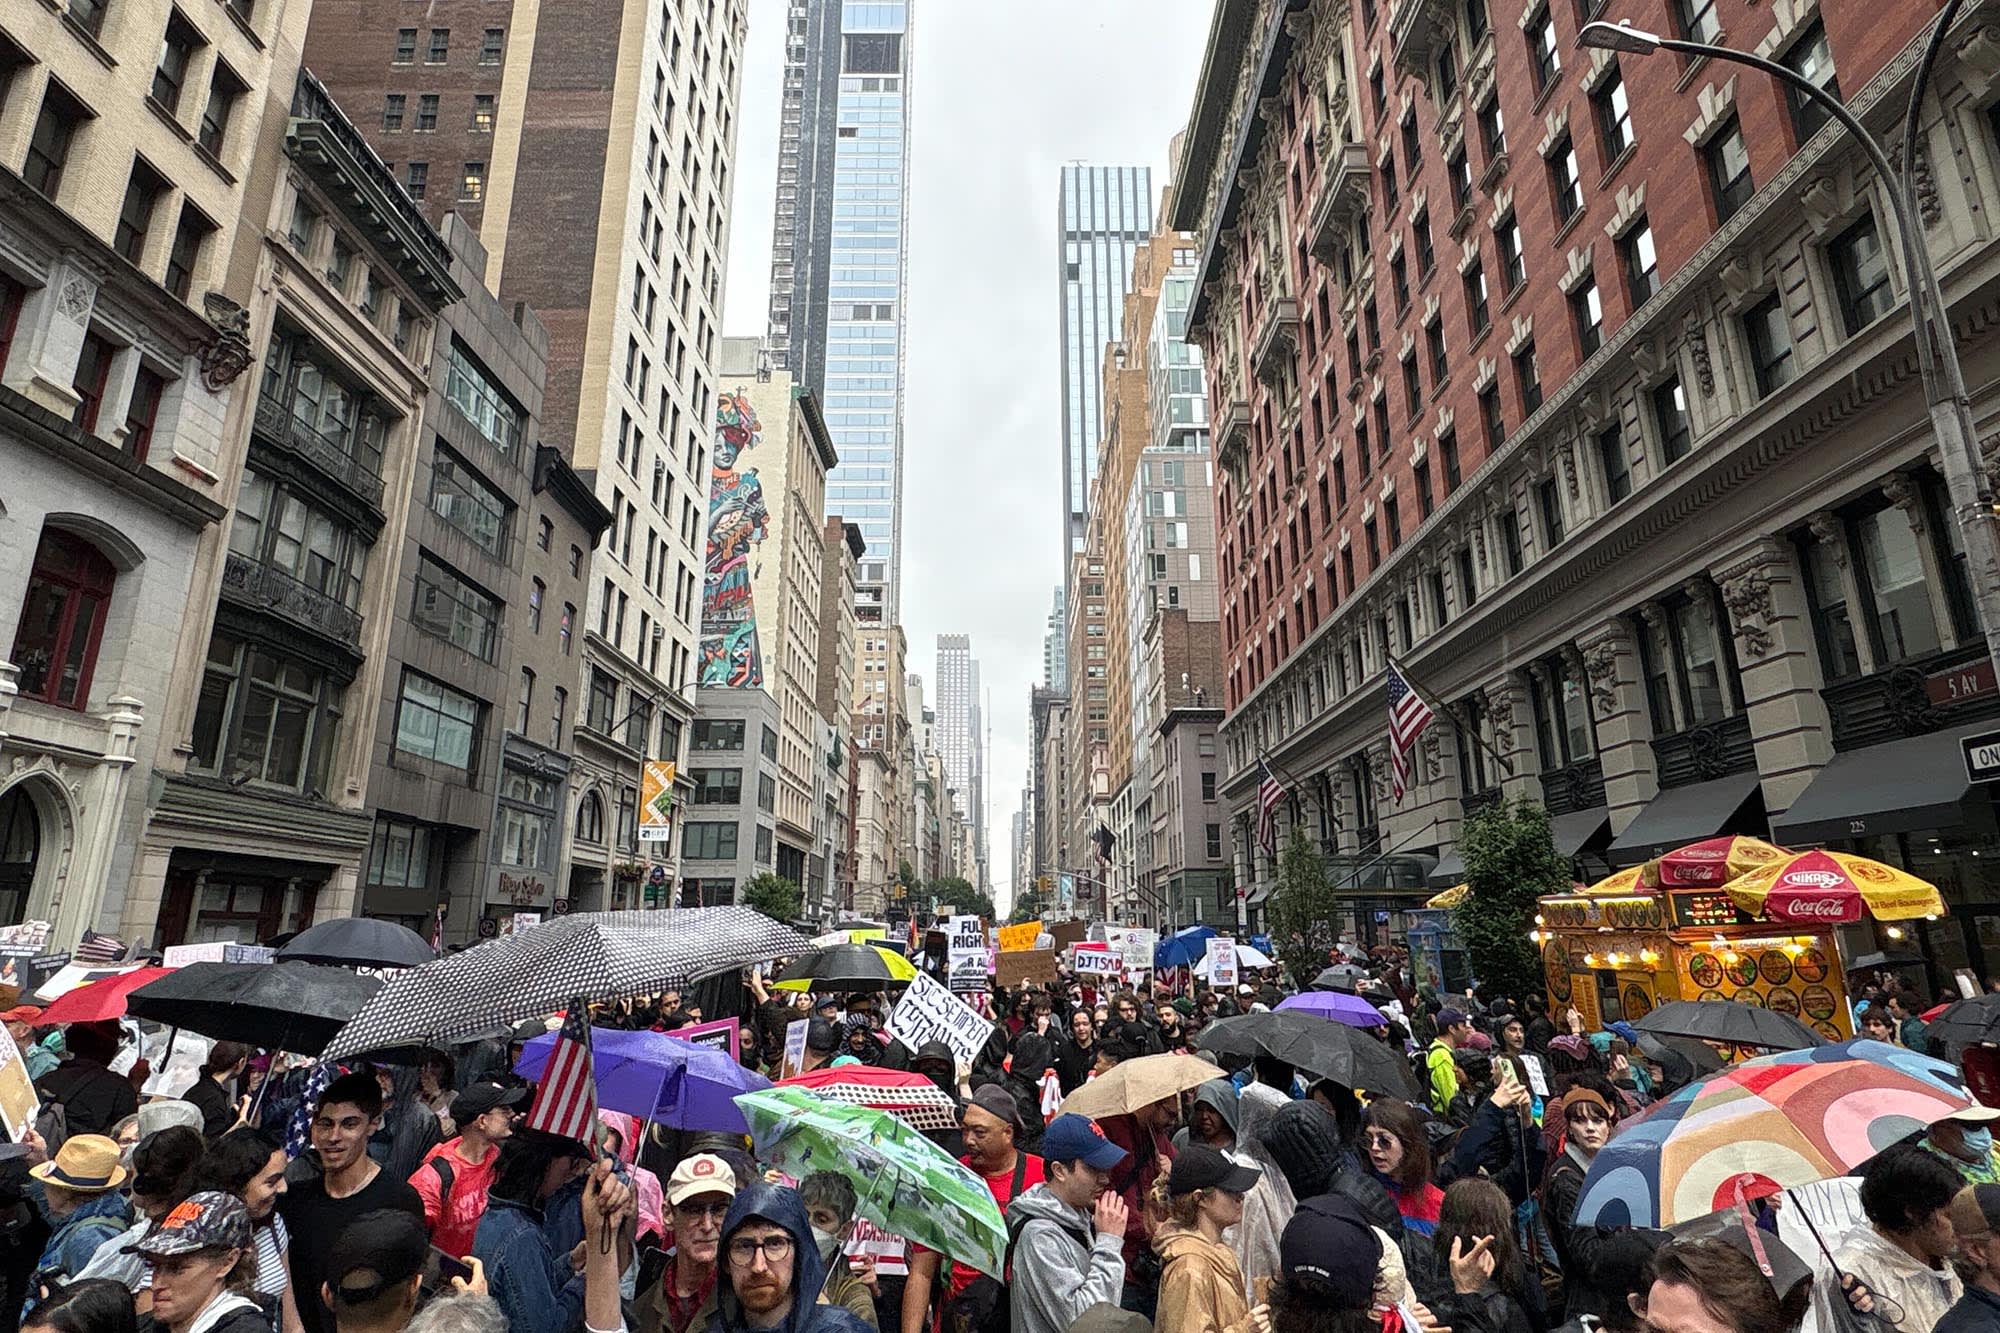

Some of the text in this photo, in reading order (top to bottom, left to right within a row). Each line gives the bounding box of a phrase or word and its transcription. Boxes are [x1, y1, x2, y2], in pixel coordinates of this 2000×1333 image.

[1948, 678, 1958, 698] 5
[1979, 746, 2000, 766] ON
[1850, 821, 1865, 833] 225
[1791, 872, 1829, 884] NIKAS
[1788, 898, 1844, 916] Coca-Cola
[961, 921, 981, 934] FUL
[953, 935, 984, 948] RIGH
